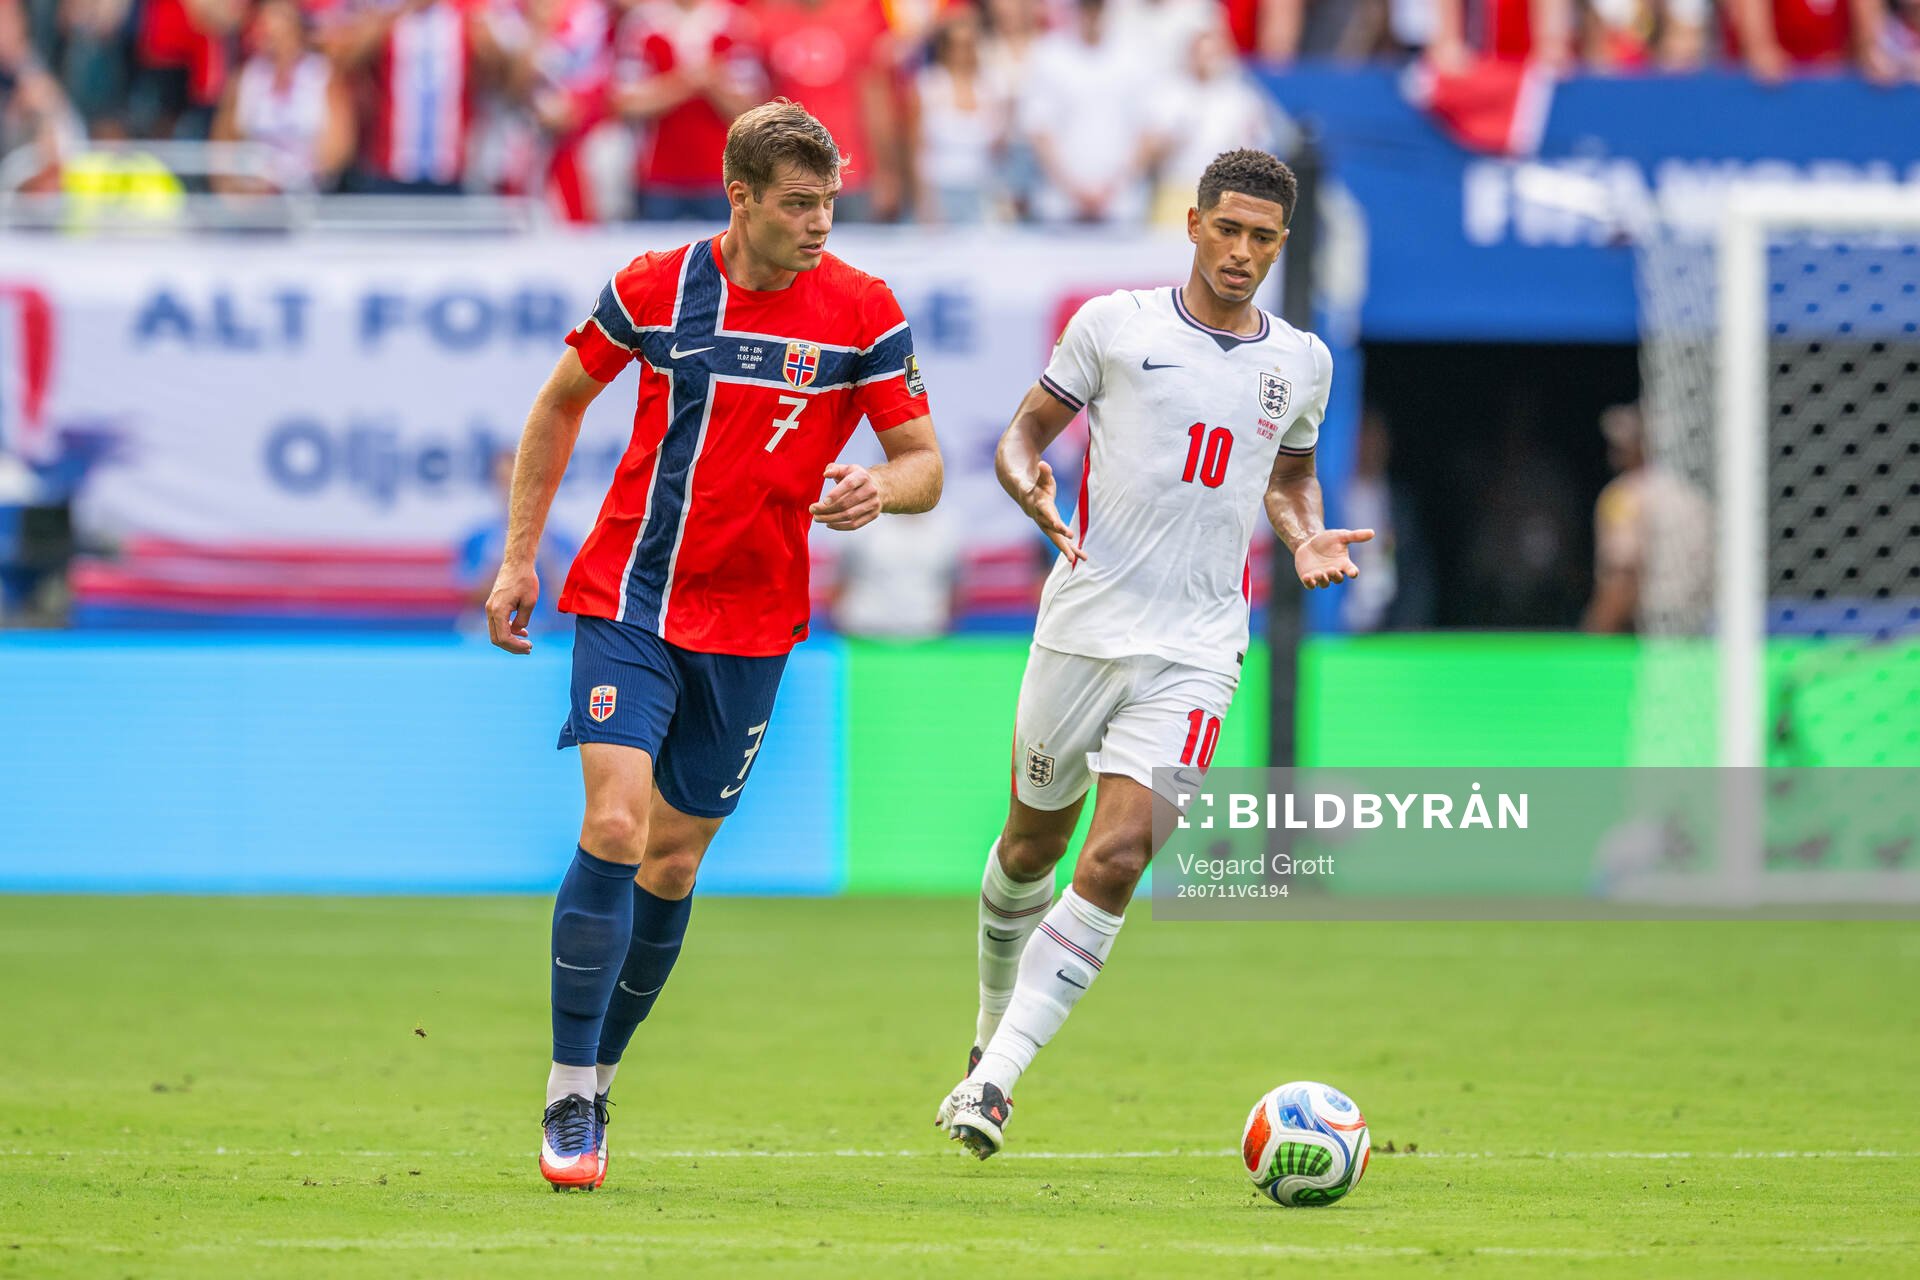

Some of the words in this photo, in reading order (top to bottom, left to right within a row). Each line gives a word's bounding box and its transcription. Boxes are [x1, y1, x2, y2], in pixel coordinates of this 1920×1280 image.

[133, 287, 308, 348] ALT
[356, 285, 572, 350] FOR
[764, 394, 809, 453] 7
[1181, 421, 1234, 489] 10
[737, 720, 768, 780] 7
[1179, 707, 1221, 776] 10
